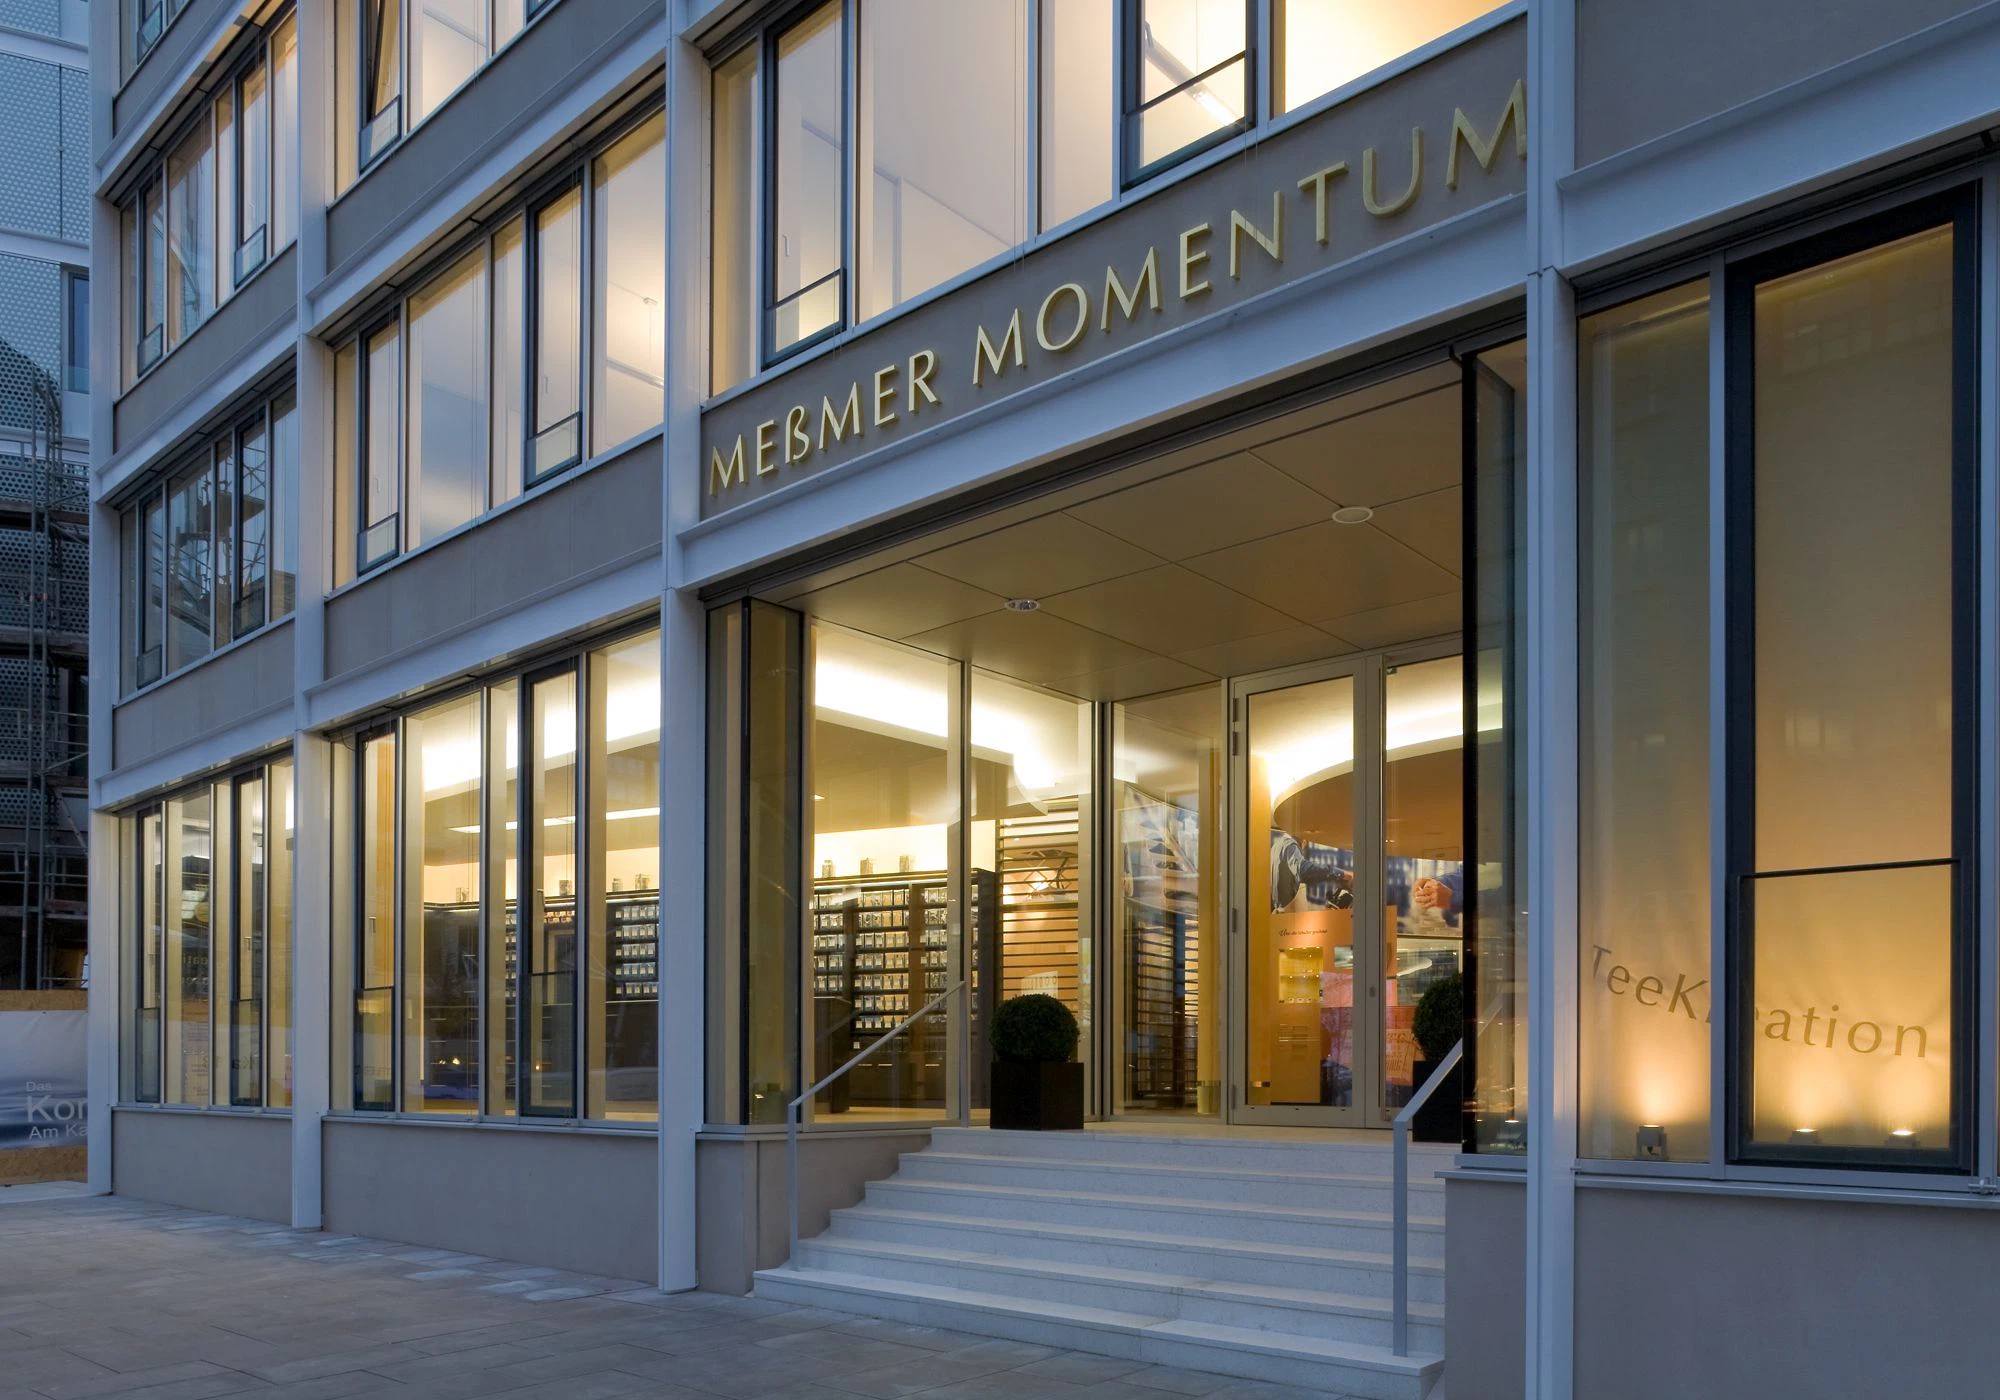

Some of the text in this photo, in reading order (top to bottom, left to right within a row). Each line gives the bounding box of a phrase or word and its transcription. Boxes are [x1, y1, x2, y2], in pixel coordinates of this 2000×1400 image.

[709, 78, 1526, 497] MEßMER MOMENTUM
[1586, 944, 1928, 1058] TeeKation
[26, 1081, 53, 1092] Das
[29, 1126, 60, 1140] Am
